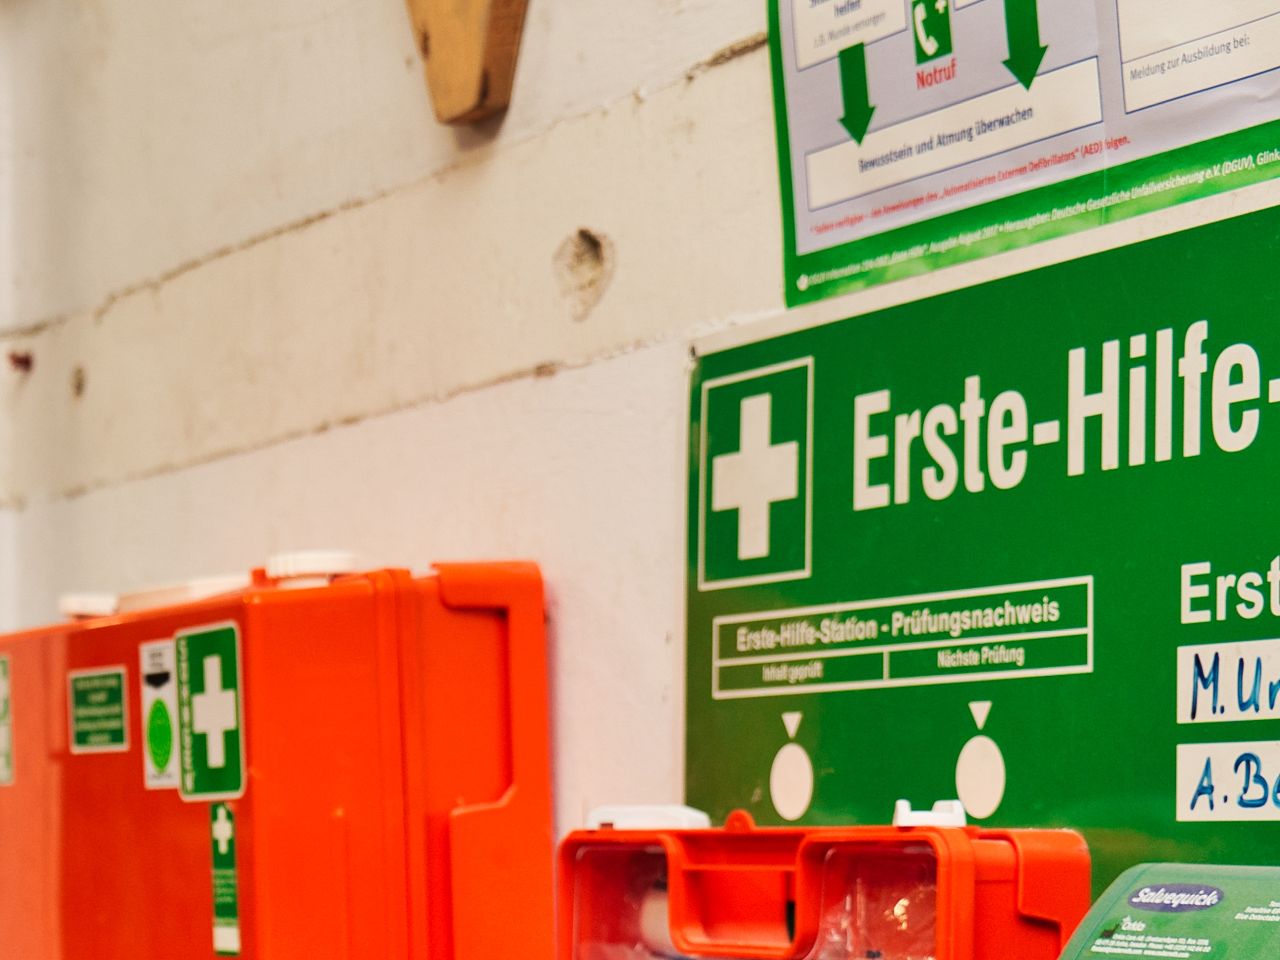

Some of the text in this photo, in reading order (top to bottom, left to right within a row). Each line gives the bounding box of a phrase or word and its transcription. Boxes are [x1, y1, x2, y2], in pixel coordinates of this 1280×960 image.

[916, 58, 957, 90] Notruf
[1129, 33, 1251, 81] Meldung zur Ausbildung bei:
[858, 106, 1034, 173] Bewusstsein und Atmung überwachen
[1081, 140, 1103, 159] (AED)
[1131, 170, 1205, 199] Unfallversicherung
[1222, 154, 1256, 177] (DGUV),
[1180, 554, 1280, 625] Erst
[736, 615, 878, 651] Erste-Hilfe-Station
[891, 596, 1060, 637] Prüfungsnachweis
[937, 645, 1025, 668] Nächste Prüfung
[1131, 887, 1219, 908] Salvequick
